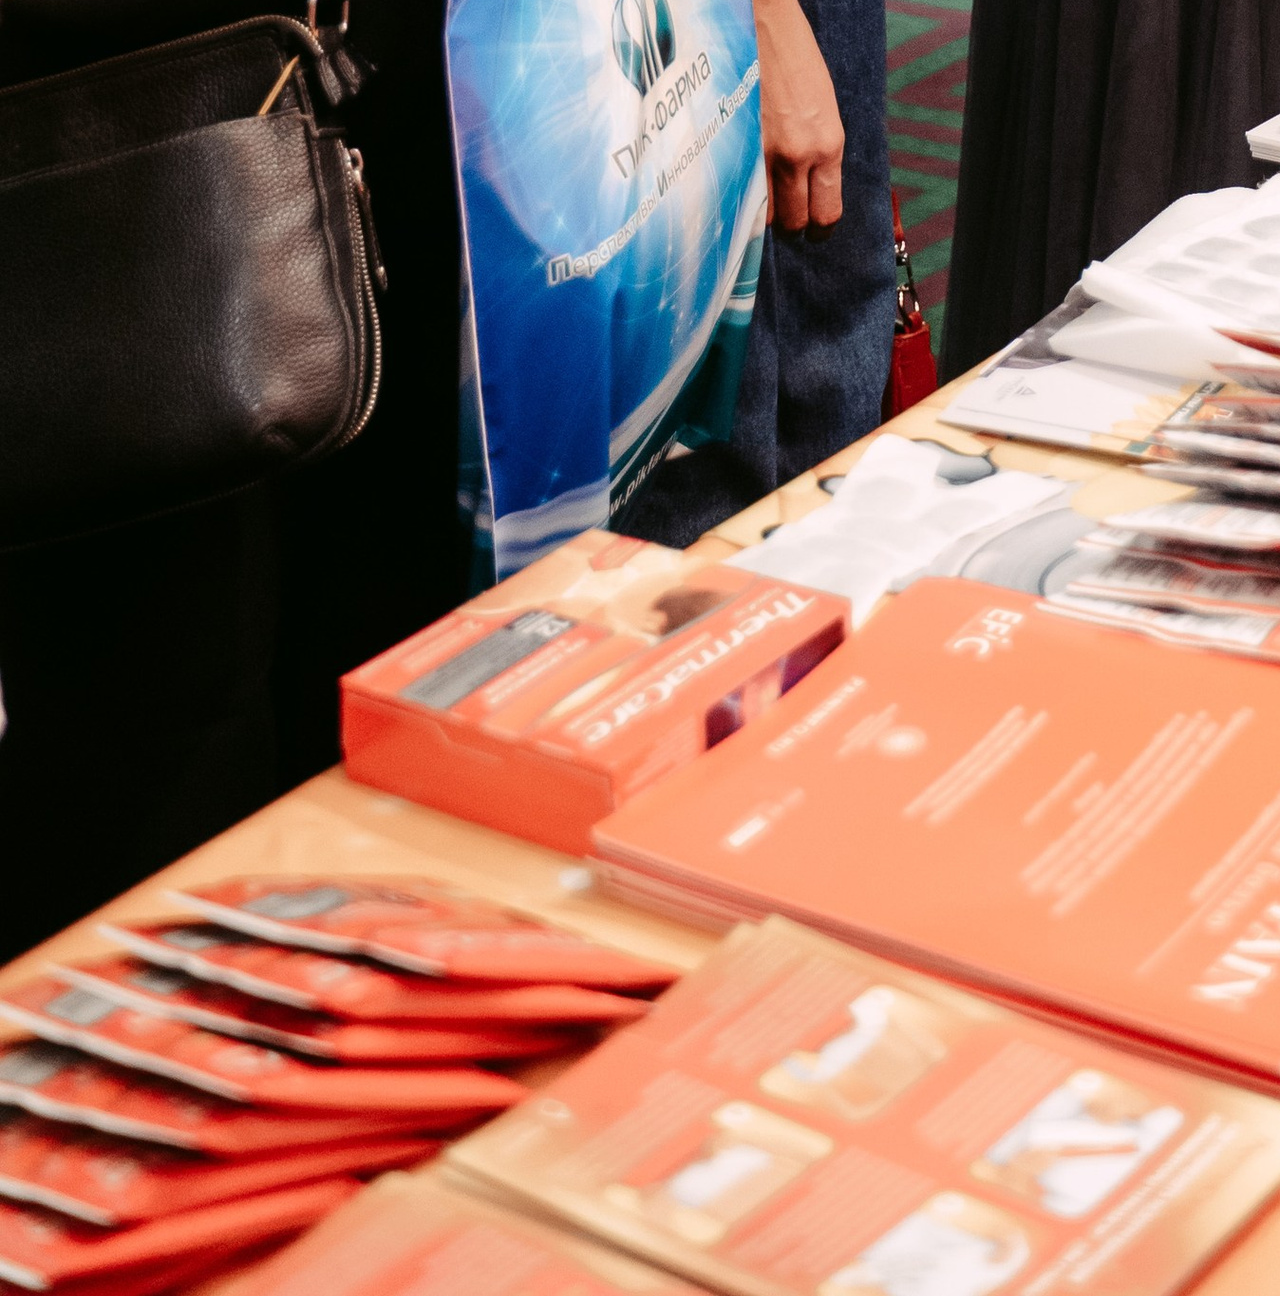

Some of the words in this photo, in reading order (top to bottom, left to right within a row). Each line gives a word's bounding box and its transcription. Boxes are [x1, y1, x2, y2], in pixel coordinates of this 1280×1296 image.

[550, 194, 657, 282] Перспективы
[656, 119, 720, 197] Инновации
[718, 61, 760, 123] Качество
[583, 591, 815, 742] ThermaCare
